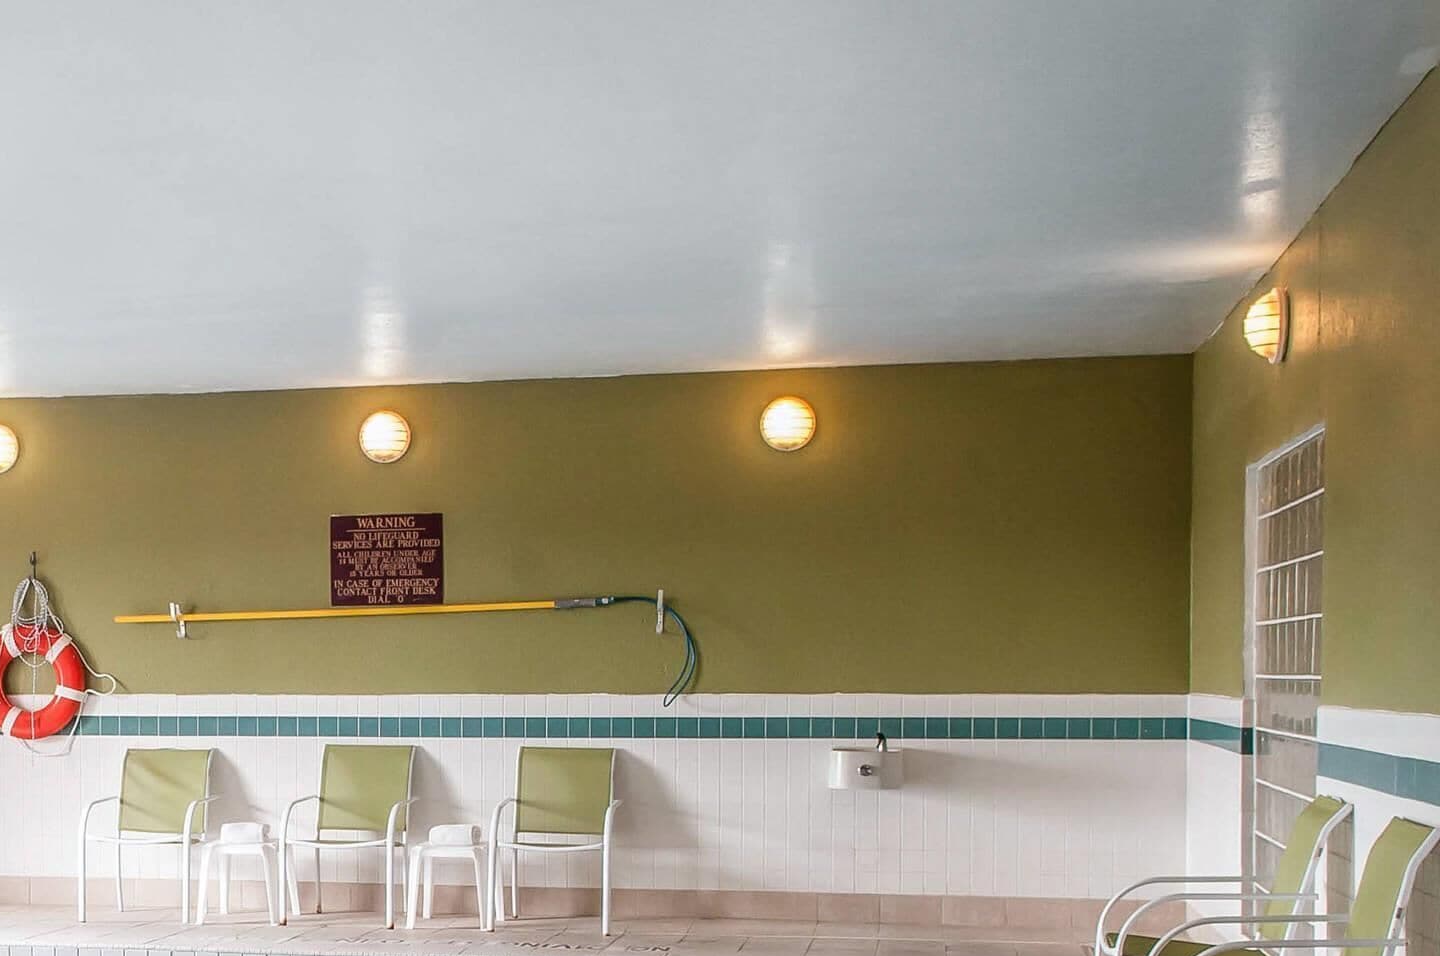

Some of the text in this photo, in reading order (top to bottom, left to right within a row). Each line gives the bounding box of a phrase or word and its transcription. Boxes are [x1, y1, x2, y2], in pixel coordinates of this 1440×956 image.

[357, 516, 416, 528] WARNING
[353, 532, 419, 541] NO LIFEGUARD
[332, 538, 440, 550] SERVICES ARE PROVIDED
[353, 550, 391, 558] CHILDREN
[334, 577, 440, 588] IN CASE OF EMERGENCY
[337, 585, 436, 596] CONTACT FRONT DESK
[368, 595, 391, 604] DIAL
